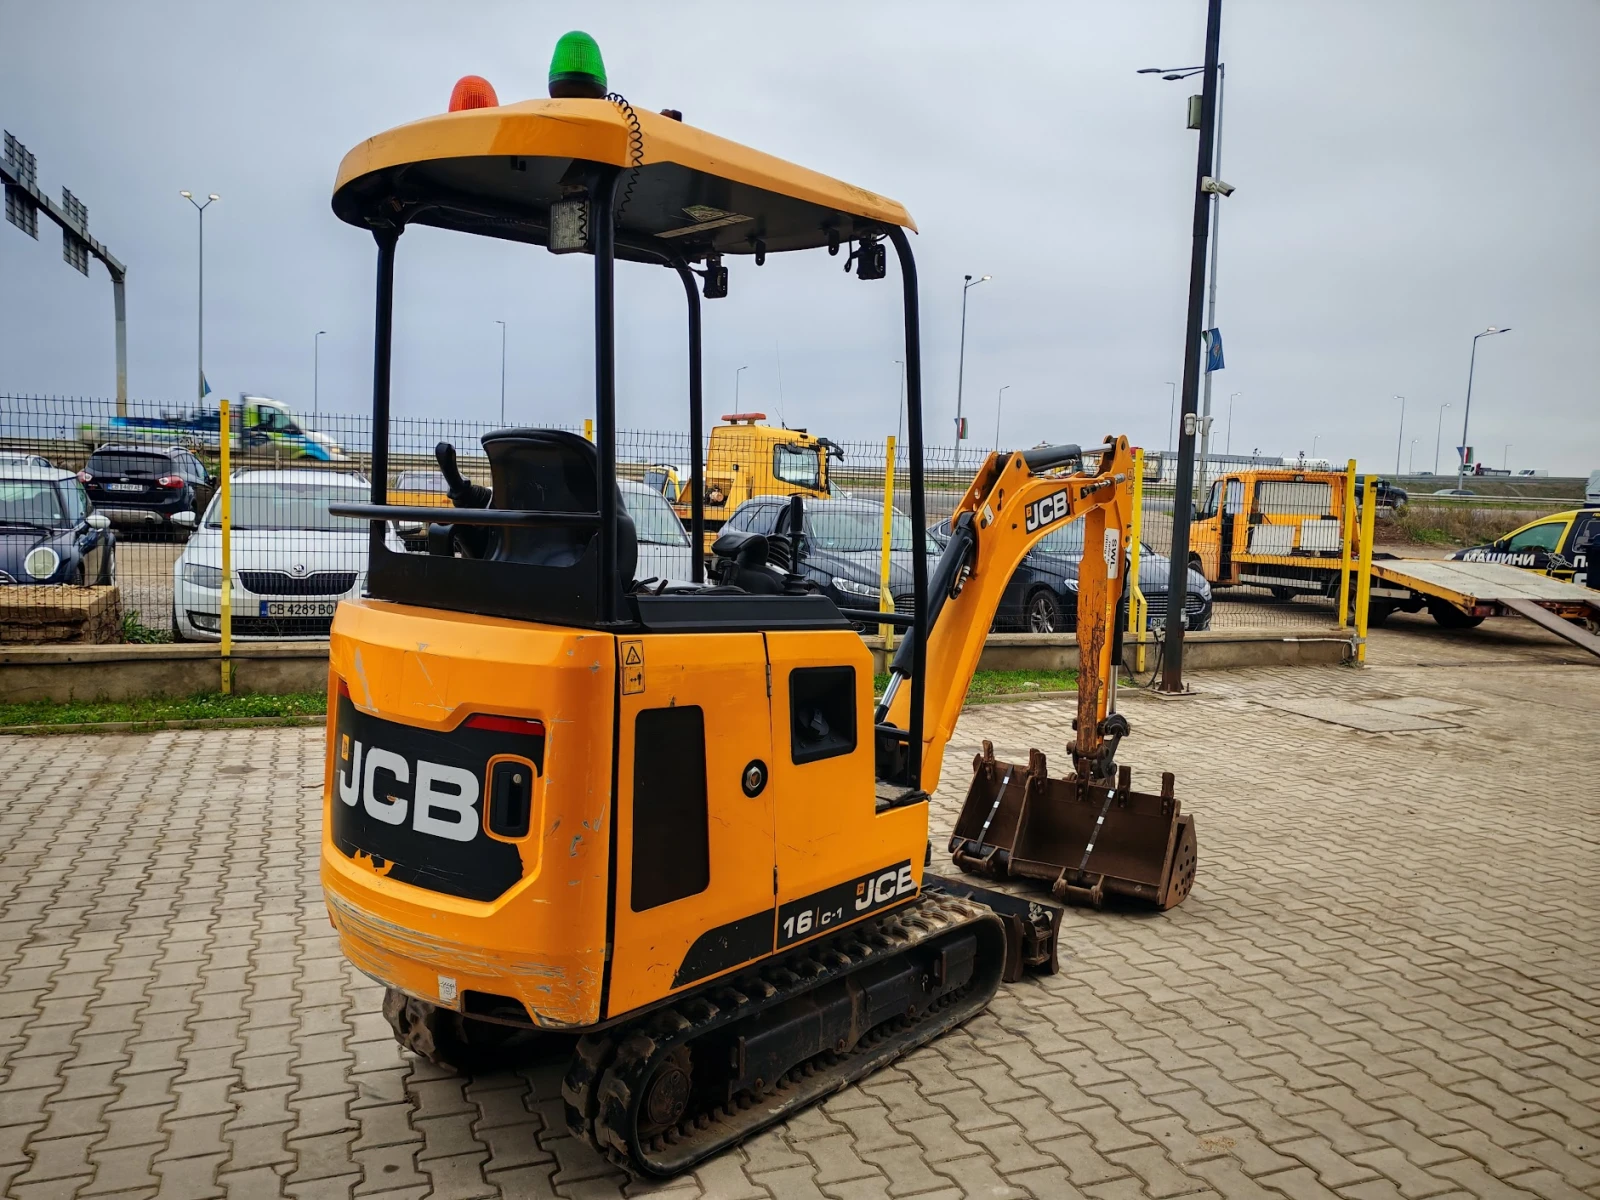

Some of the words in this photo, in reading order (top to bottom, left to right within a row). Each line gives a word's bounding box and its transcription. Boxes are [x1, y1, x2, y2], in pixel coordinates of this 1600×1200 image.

[1026, 491, 1069, 531] JCB
[1462, 552, 1536, 567] МАШИНИ
[269, 603, 285, 615] CB
[287, 603, 317, 615] 4289
[339, 740, 480, 842] JCB
[783, 909, 813, 939] 16
